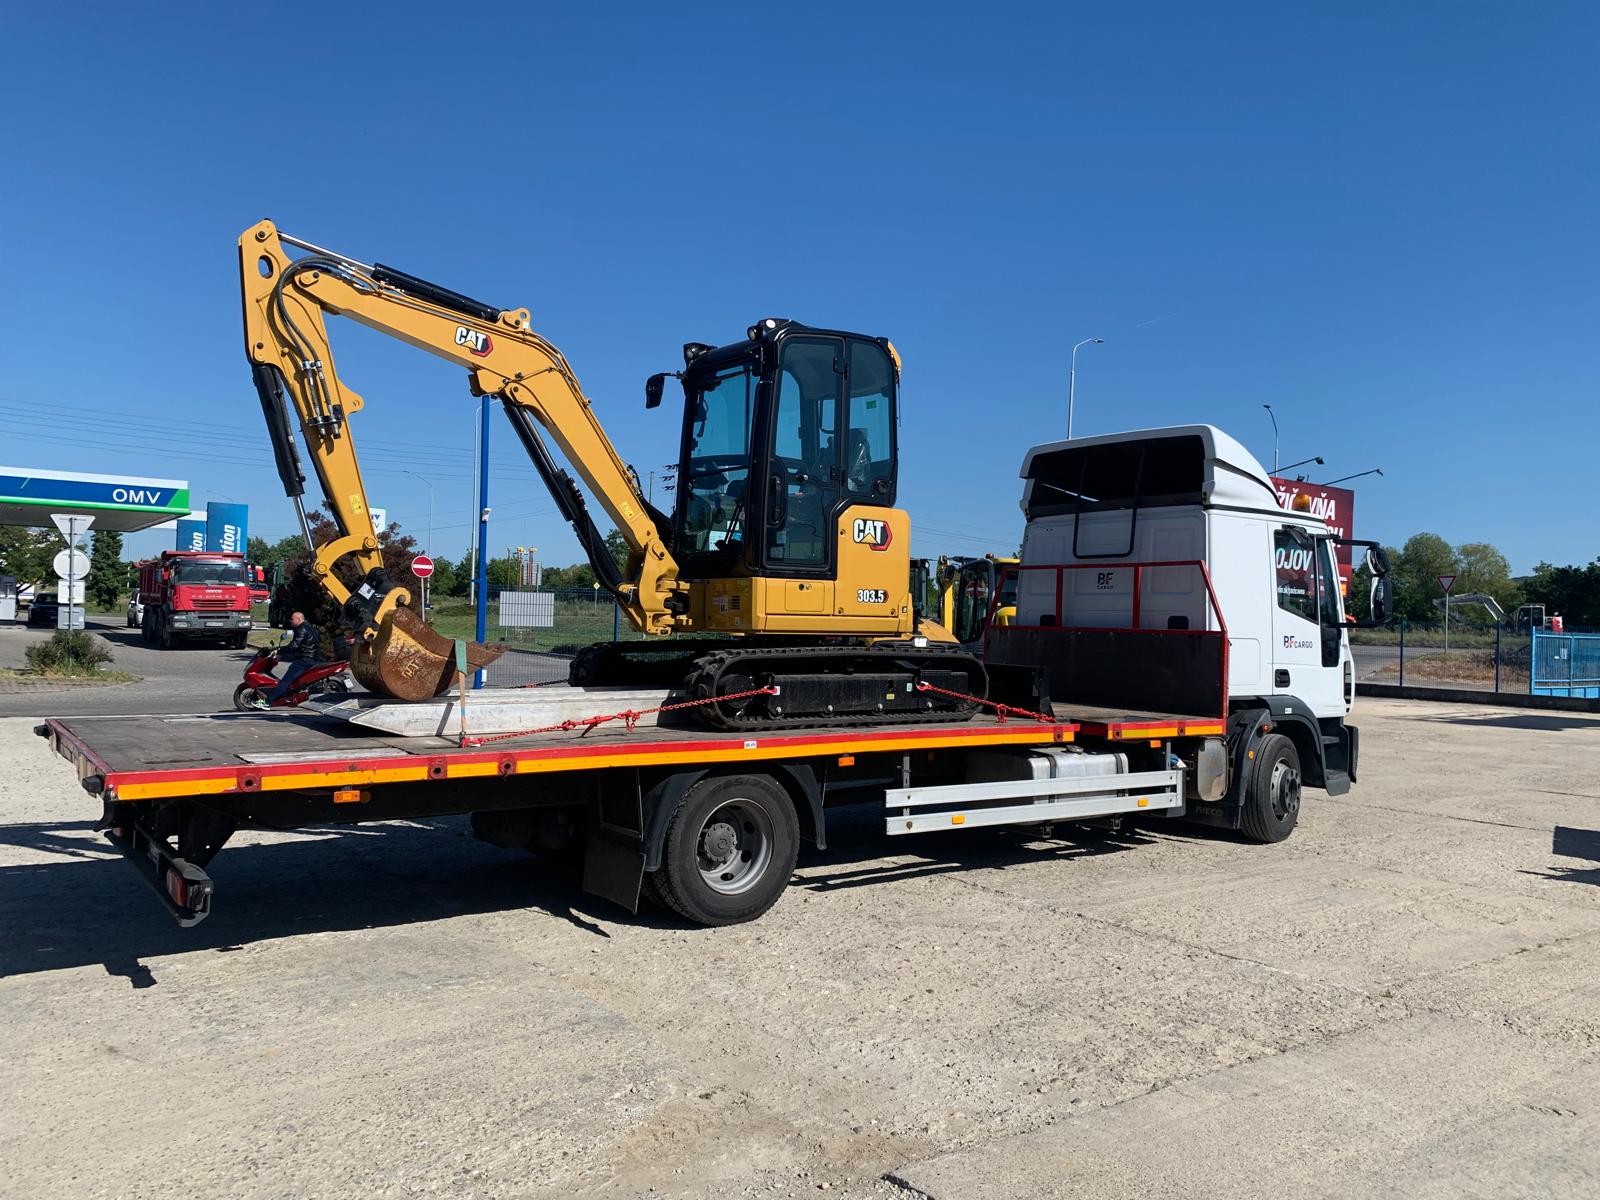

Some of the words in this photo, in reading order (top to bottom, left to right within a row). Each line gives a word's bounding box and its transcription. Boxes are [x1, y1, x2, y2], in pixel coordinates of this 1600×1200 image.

[455, 326, 487, 351] CAT
[112, 488, 161, 504] OMV
[853, 519, 884, 545] CAT
[857, 589, 884, 603] 303.5
[401, 658, 419, 680] CAT
